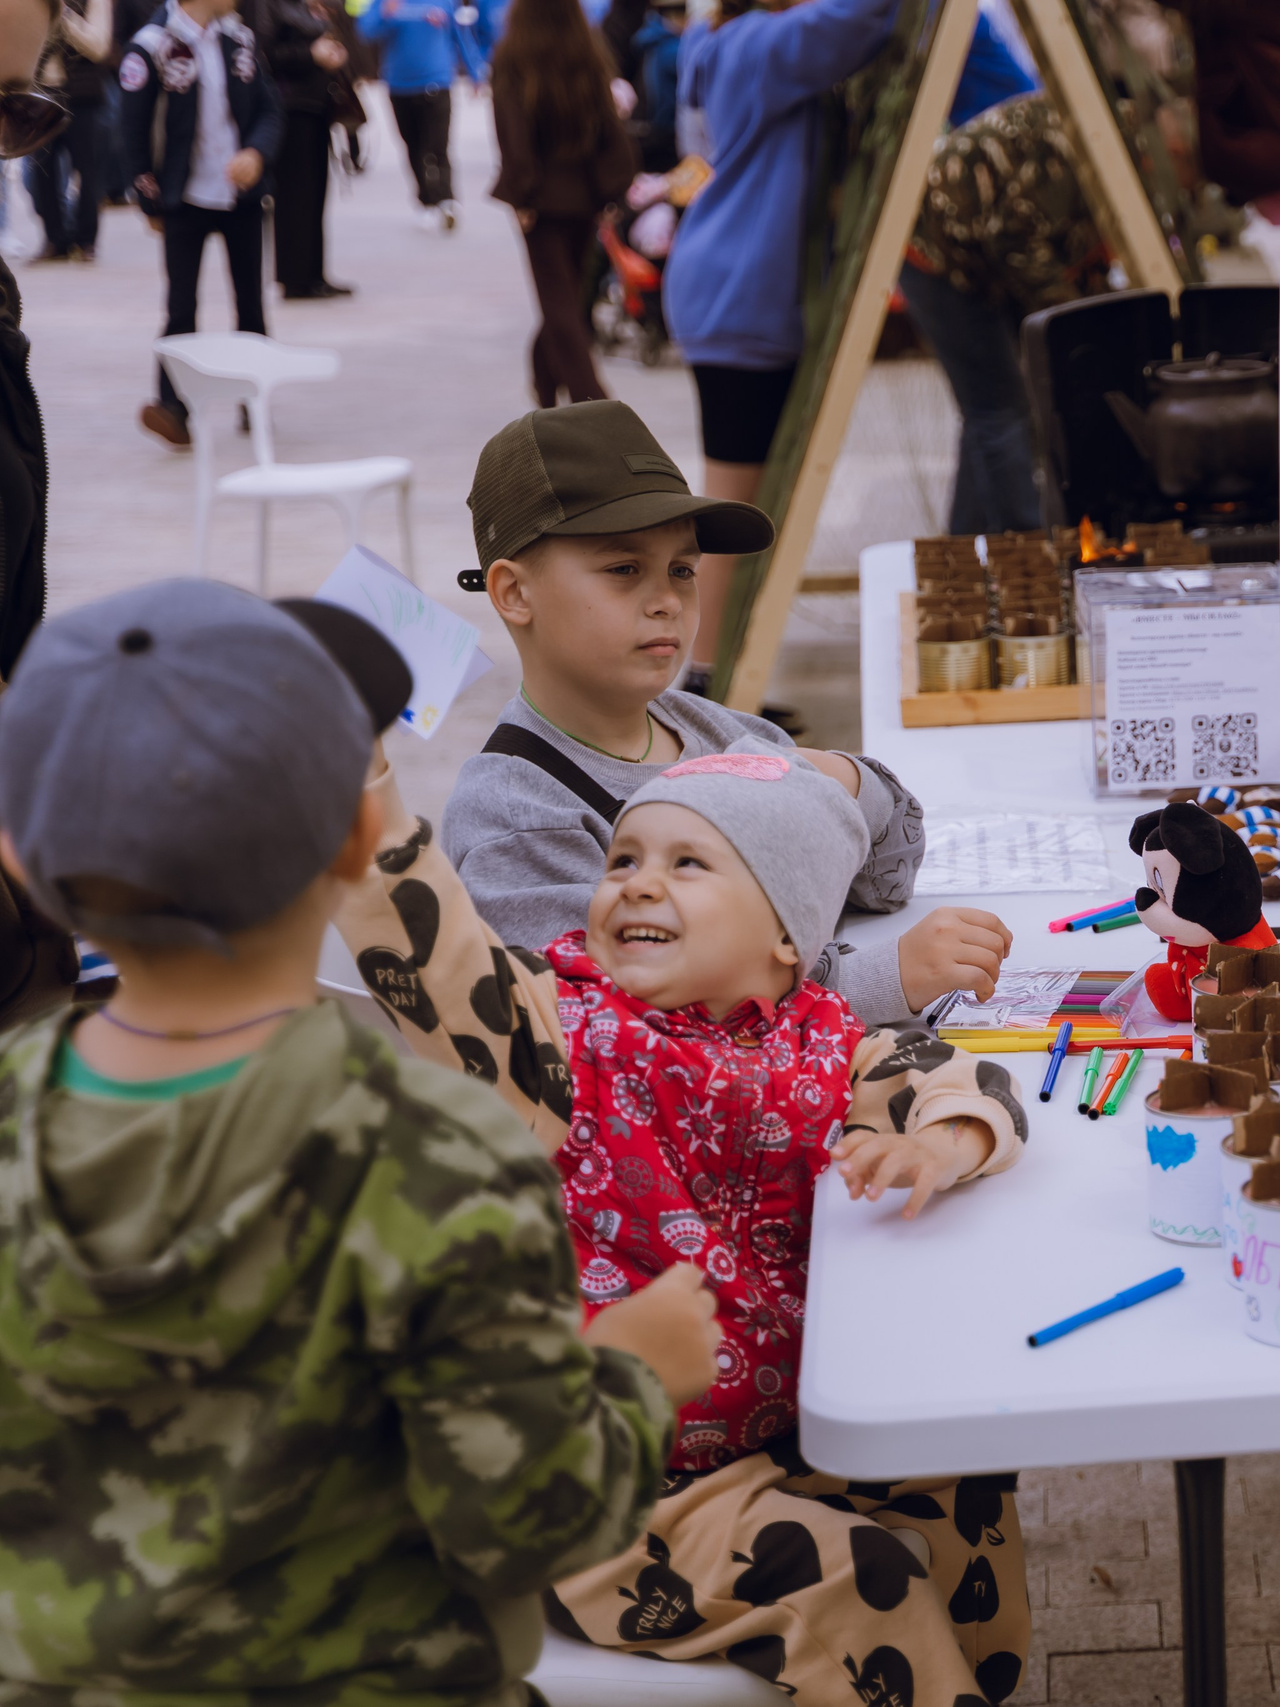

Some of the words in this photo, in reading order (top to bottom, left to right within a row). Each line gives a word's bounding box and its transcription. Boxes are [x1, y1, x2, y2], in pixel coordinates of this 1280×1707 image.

[389, 991, 417, 1008] DAY
[636, 1586, 668, 1635] TRULY
[657, 1596, 687, 1630] NICE
